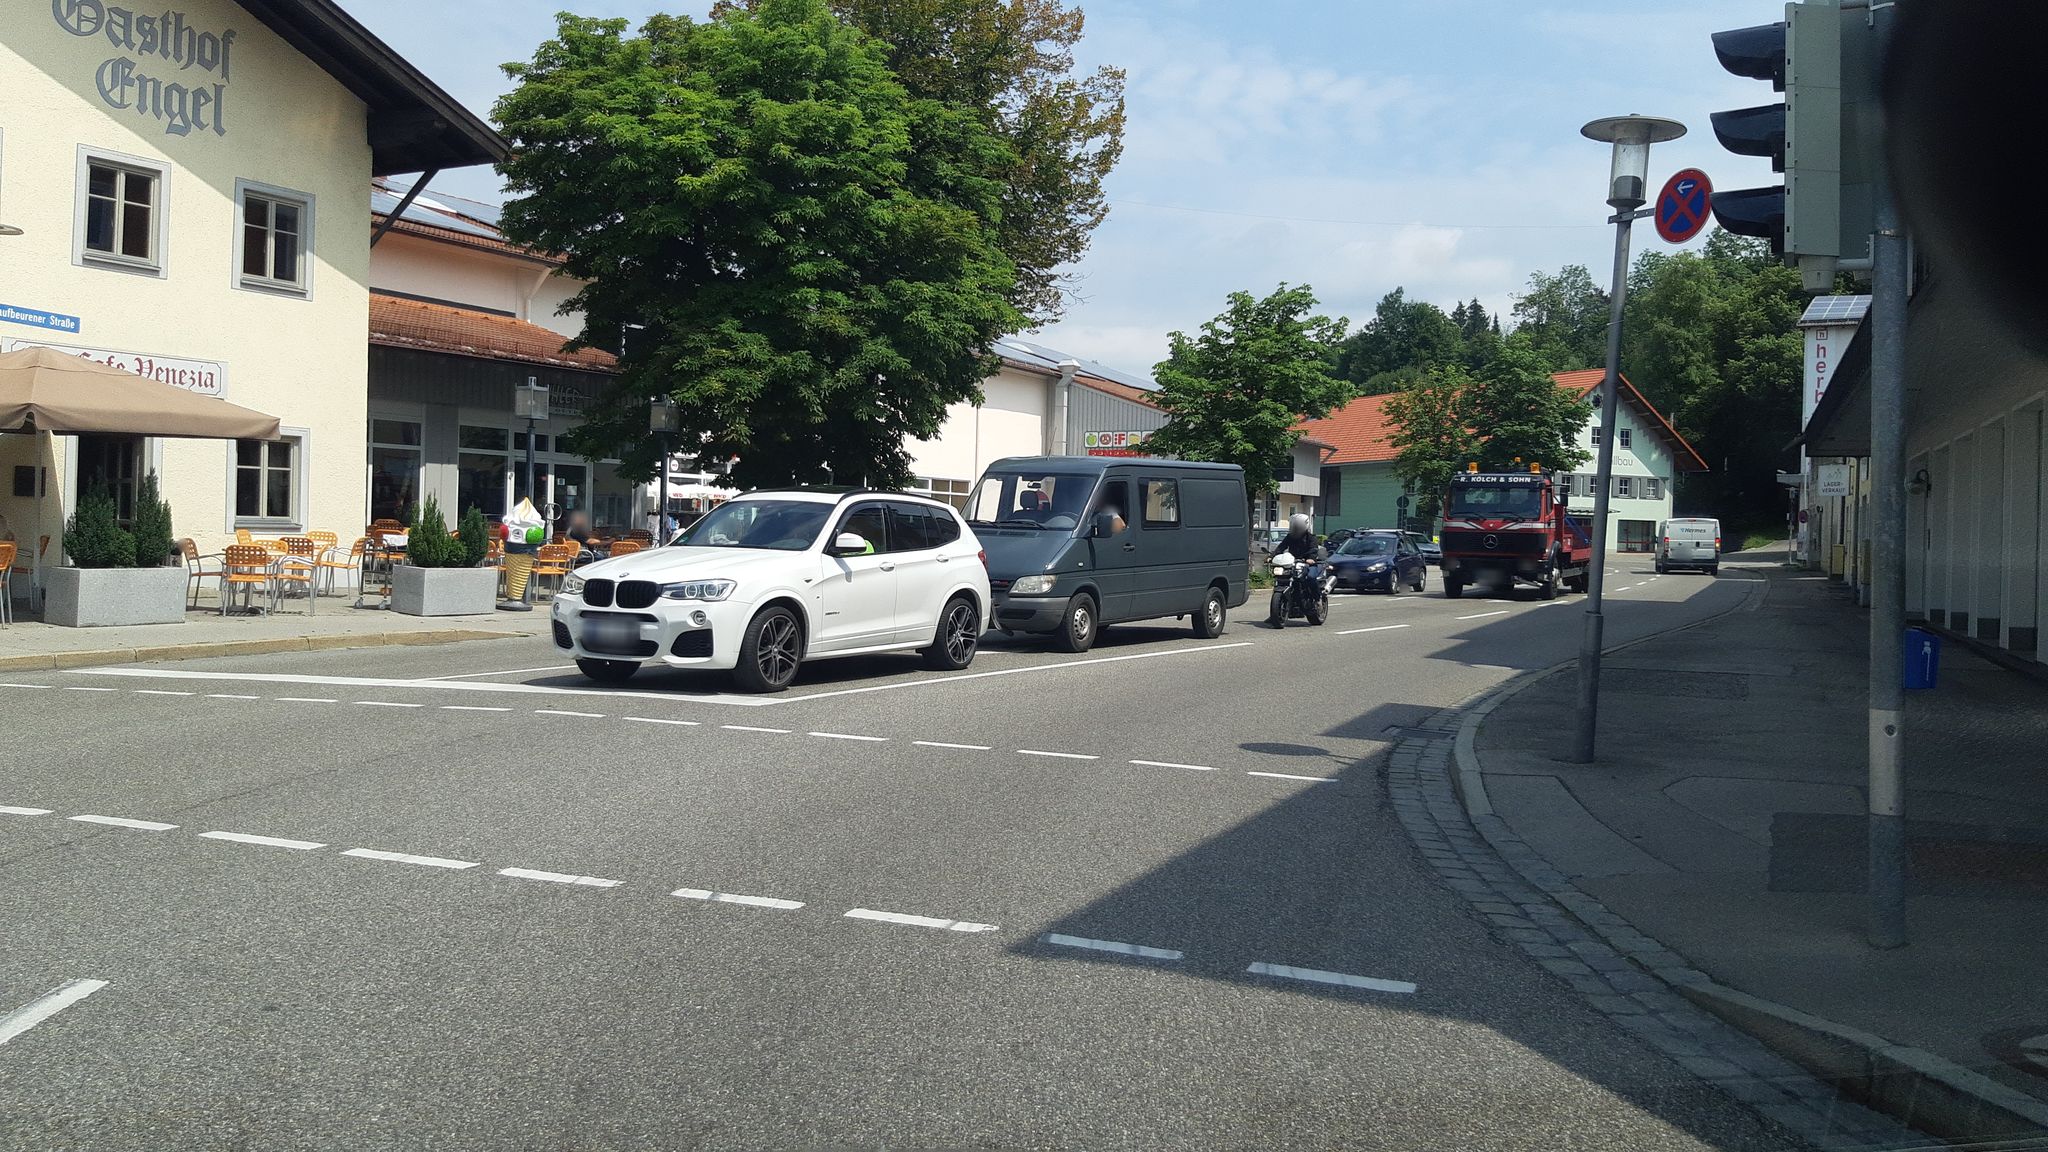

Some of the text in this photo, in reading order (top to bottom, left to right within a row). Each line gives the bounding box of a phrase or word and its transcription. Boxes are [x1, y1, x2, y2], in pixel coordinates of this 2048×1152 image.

[52, 0, 237, 84] Gasthof
[95, 56, 226, 137] Engel
[0, 308, 76, 329] ufbeurener Straße
[134, 357, 215, 392] Venezia
